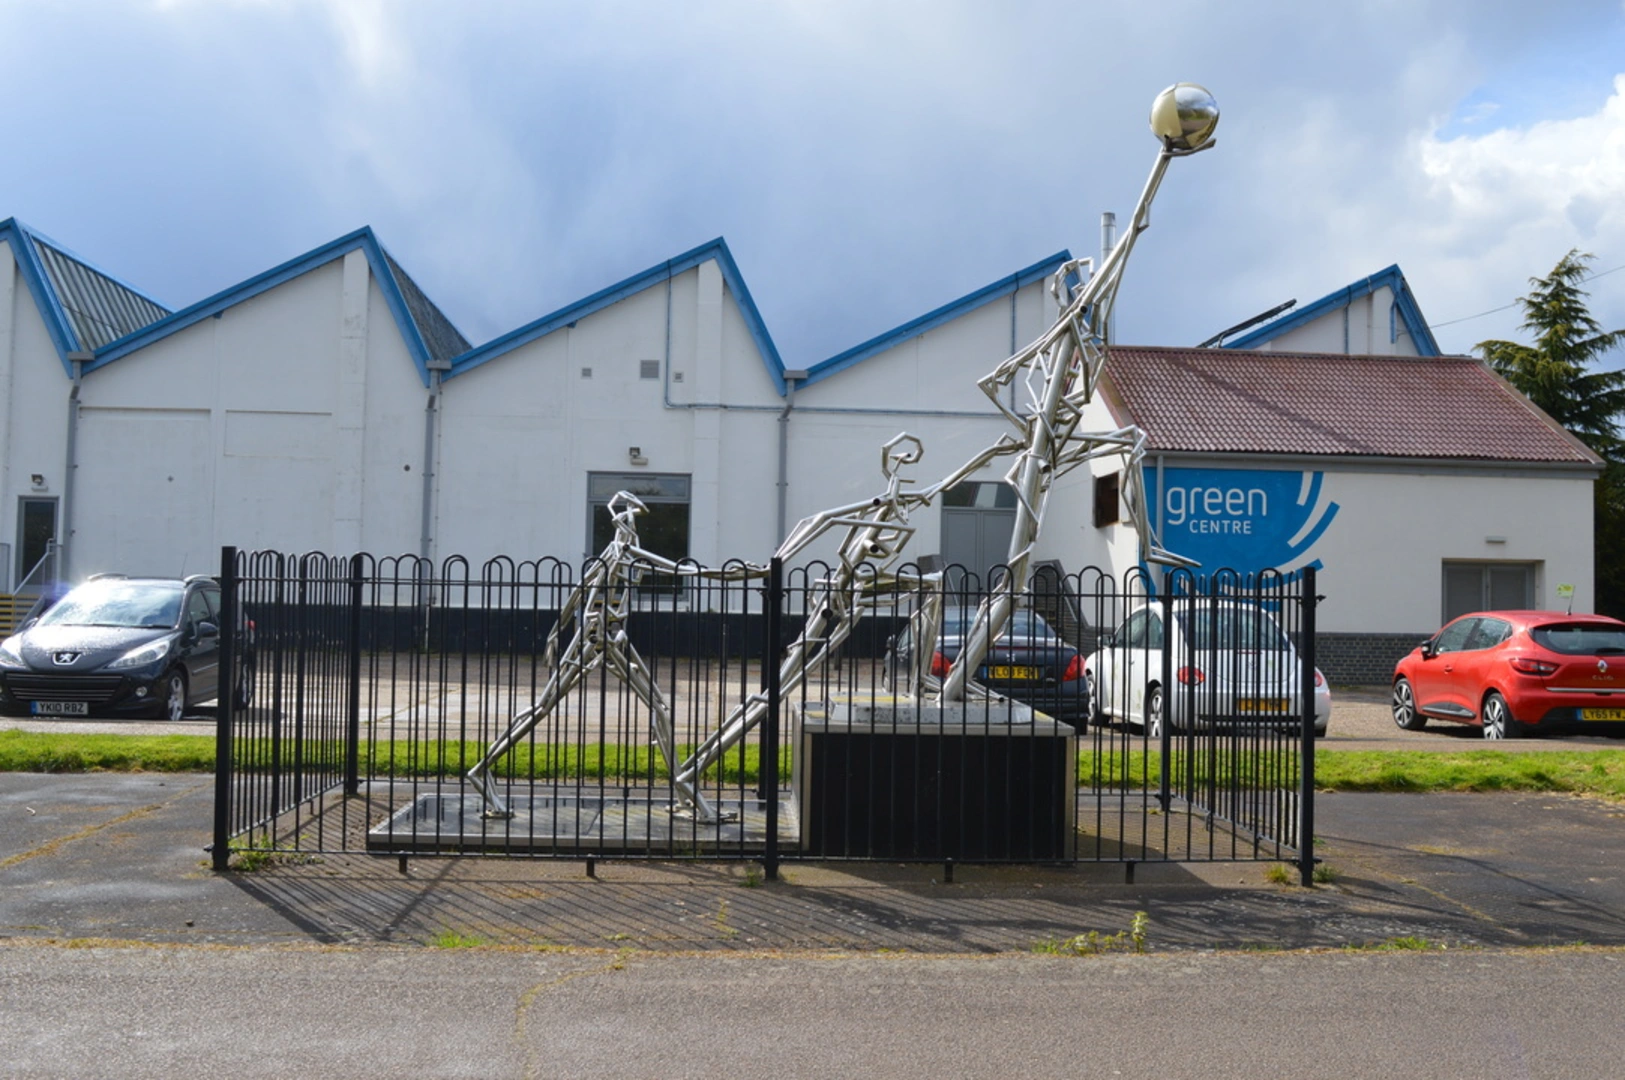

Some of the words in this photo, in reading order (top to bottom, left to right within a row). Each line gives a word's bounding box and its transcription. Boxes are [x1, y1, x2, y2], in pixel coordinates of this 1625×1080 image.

[1166, 486, 1268, 525] green
[1189, 519, 1252, 535] CENTRE
[64, 702, 84, 713] RBZ
